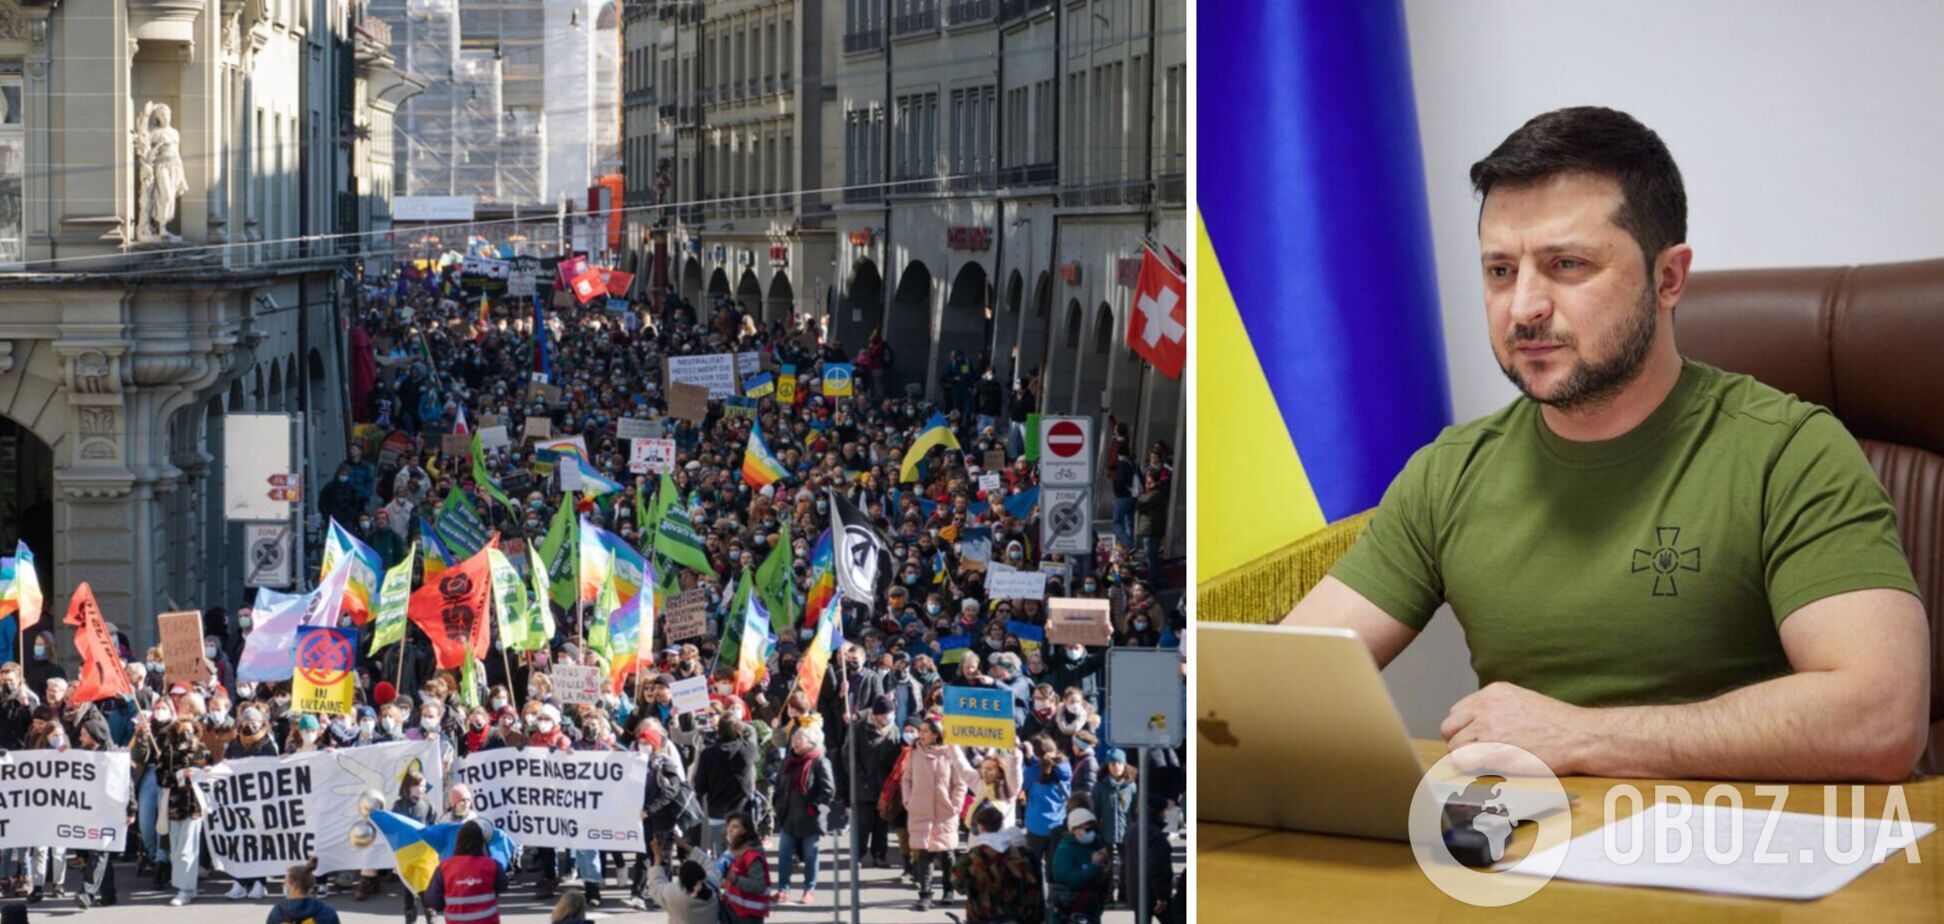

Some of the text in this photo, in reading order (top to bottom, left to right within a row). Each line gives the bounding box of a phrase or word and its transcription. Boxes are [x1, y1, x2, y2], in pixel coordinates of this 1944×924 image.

[1055, 492, 1077, 500] ZONE
[257, 528, 278, 537] ZONE
[314, 687, 328, 699] IN
[300, 698, 344, 713] UKRAINE
[960, 696, 1002, 711] FREE
[951, 725, 1004, 740] UKRAINE
[1, 760, 96, 781] ROUPES
[458, 758, 624, 784] TRUPPENABZUG
[198, 765, 312, 806] FRIEDEN
[472, 787, 603, 812] ÖLKERRECHT
[262, 799, 306, 830] DIE
[211, 832, 315, 863] UKRAINE
